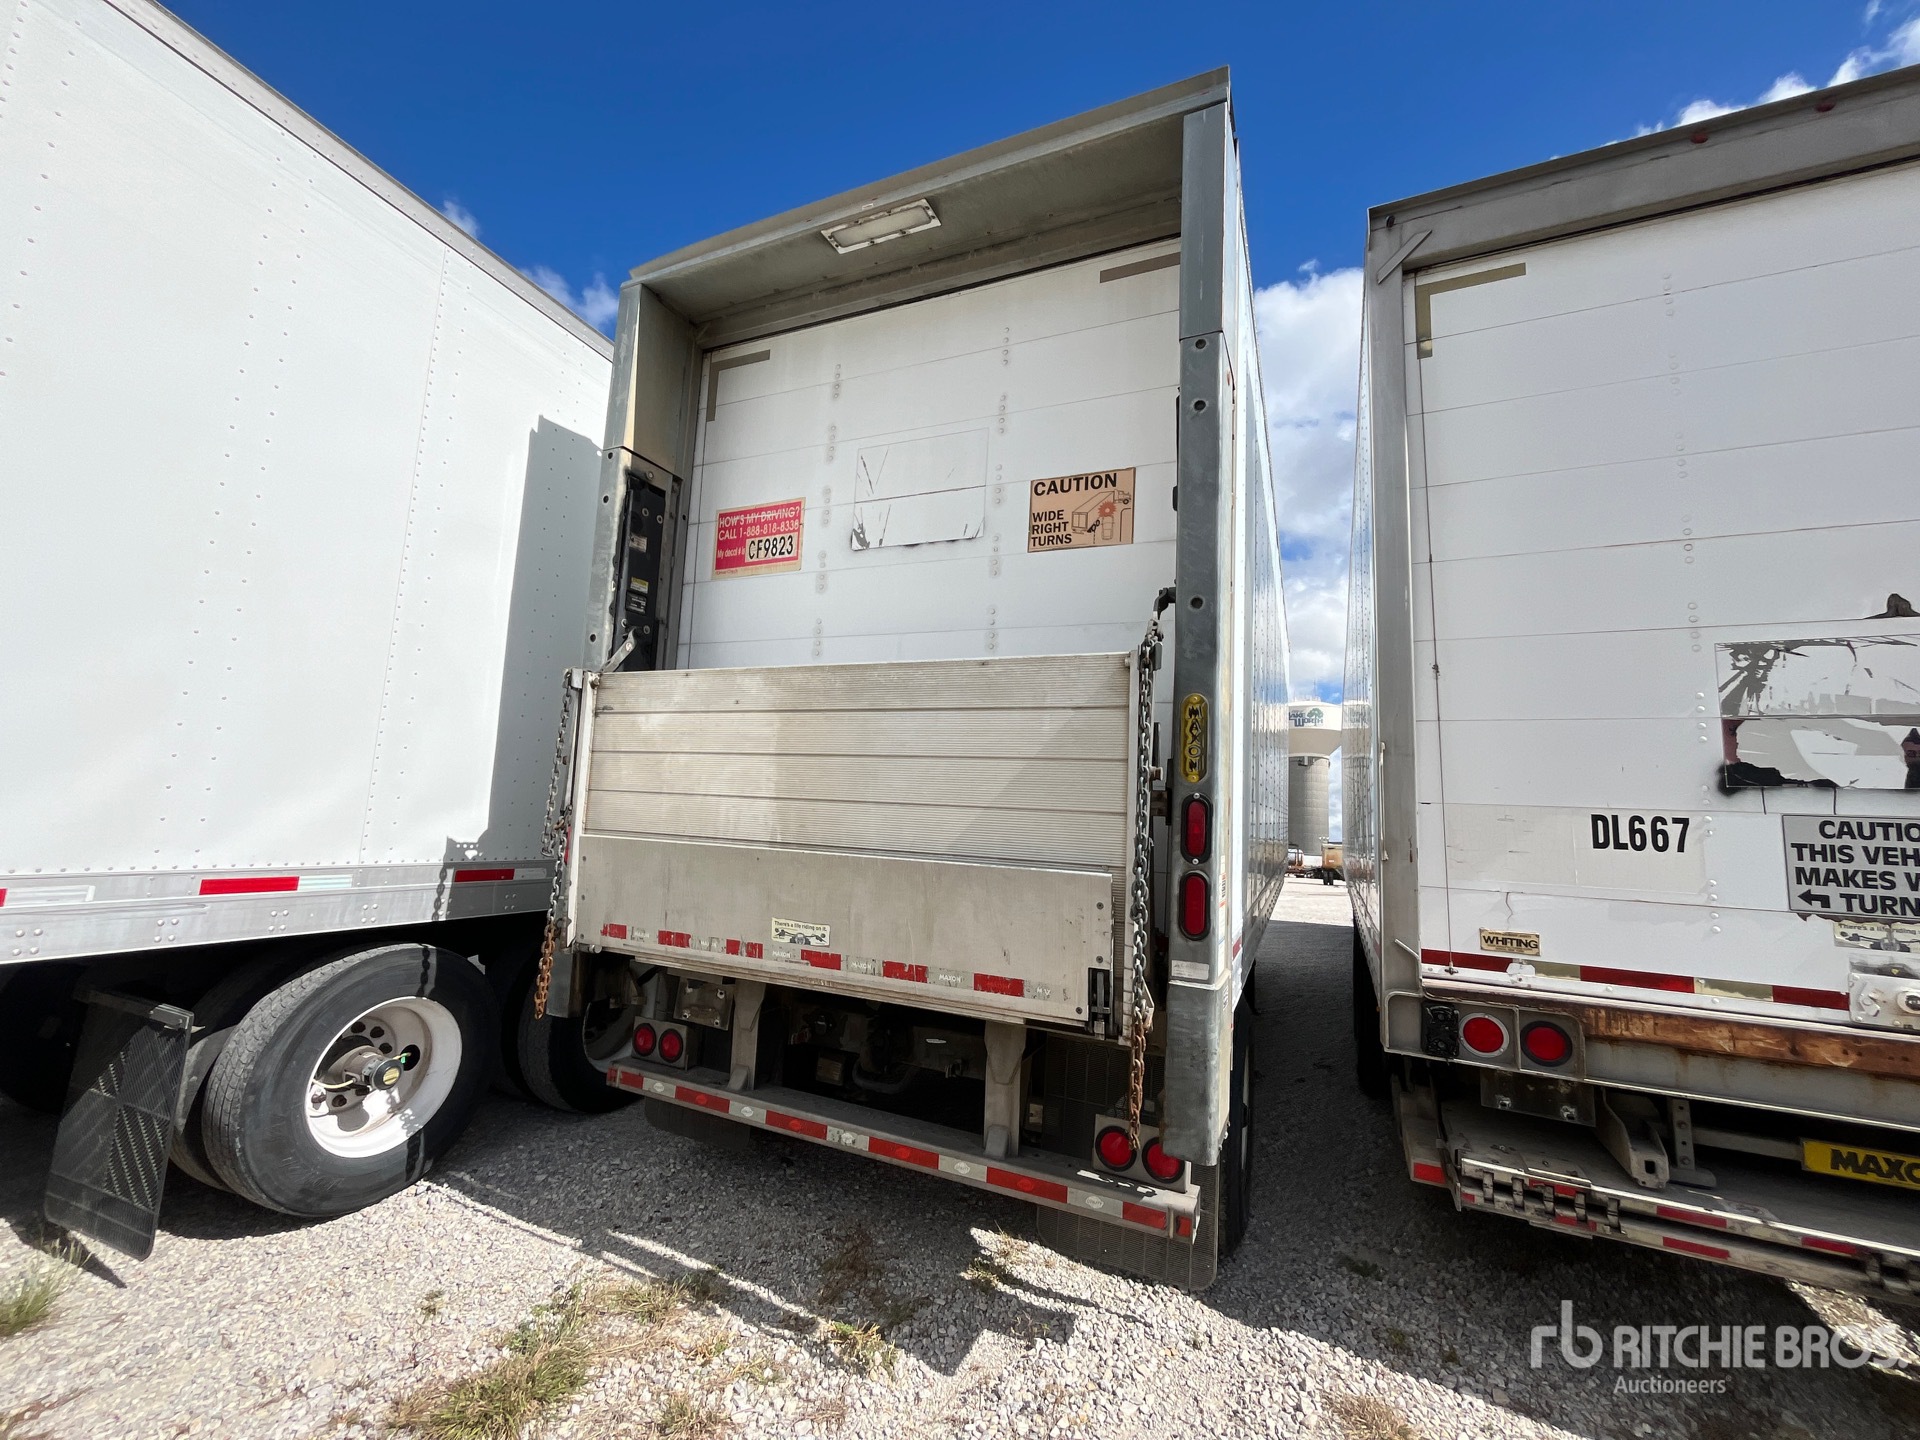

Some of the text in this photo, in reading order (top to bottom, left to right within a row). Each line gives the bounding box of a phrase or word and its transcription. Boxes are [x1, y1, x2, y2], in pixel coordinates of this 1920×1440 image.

[1033, 473, 1117, 496] CAUTION
[719, 506, 800, 528] HOW'S MY DRIVING?
[1032, 510, 1065, 523] WIDE
[718, 529, 737, 541] CALL
[1032, 521, 1069, 535] RIGHT
[748, 535, 794, 560] CF9823
[1031, 533, 1072, 547] TURNS
[1185, 703, 1203, 773] MAXON
[1590, 814, 1690, 853] DL667
[1790, 843, 1855, 864] THIS
[1795, 866, 1897, 891] MAKES
[1482, 935, 1538, 949] WHITING
[939, 973, 961, 982] MAXON
